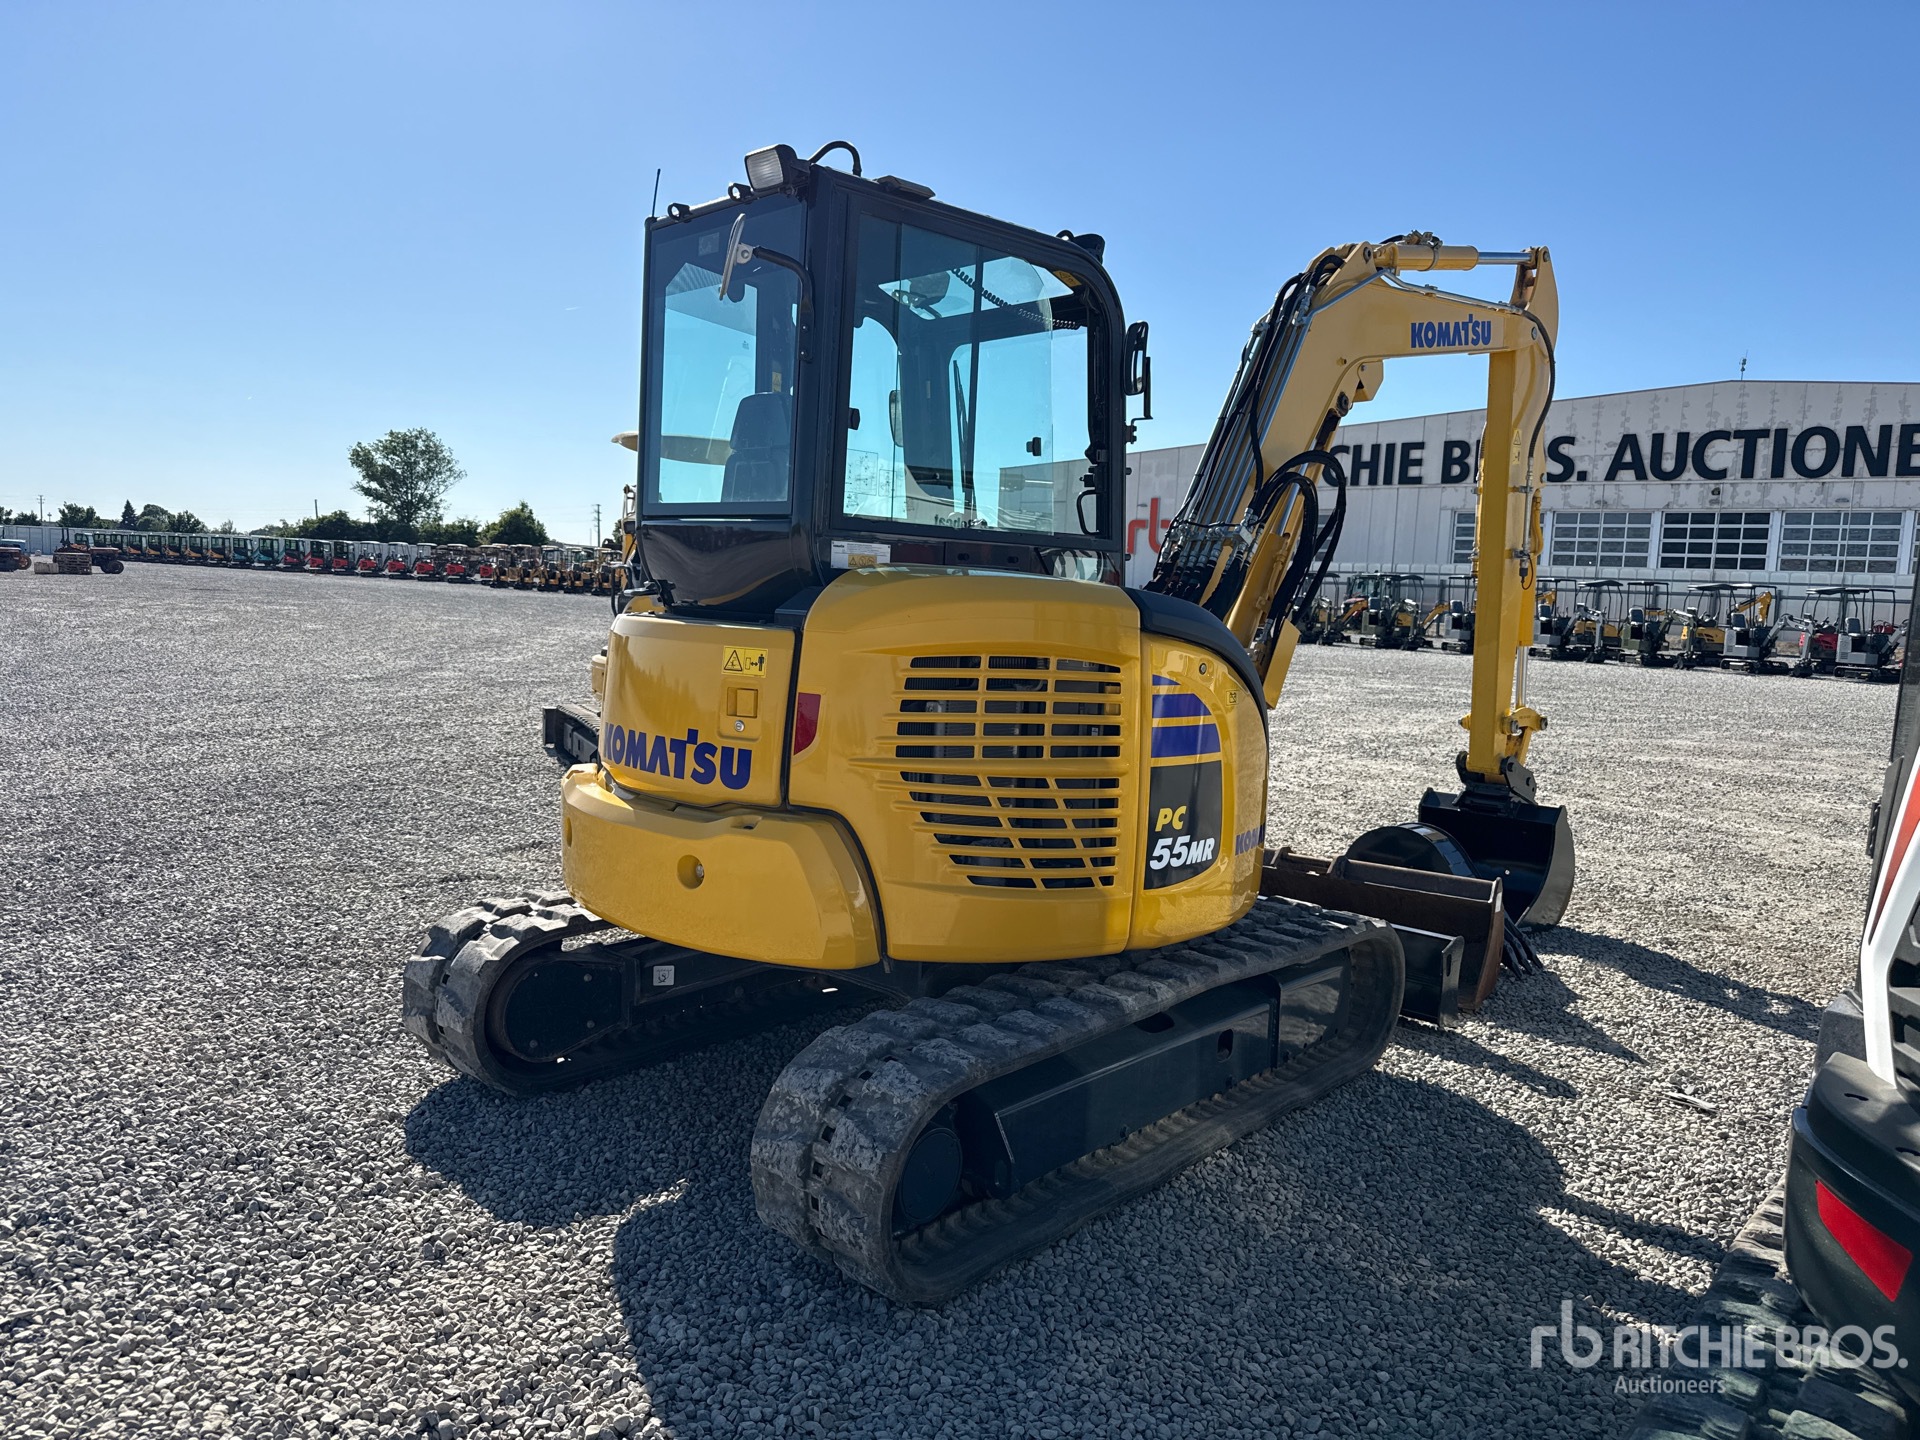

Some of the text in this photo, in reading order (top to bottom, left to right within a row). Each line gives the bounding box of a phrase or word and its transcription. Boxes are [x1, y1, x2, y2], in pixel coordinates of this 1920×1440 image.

[1411, 314, 1492, 348] KOMATSU
[1604, 423, 1920, 481] AUCTIONE
[604, 722, 753, 790] KOMATSU
[1155, 805, 1187, 832] PC
[1149, 834, 1216, 870] 55MR
